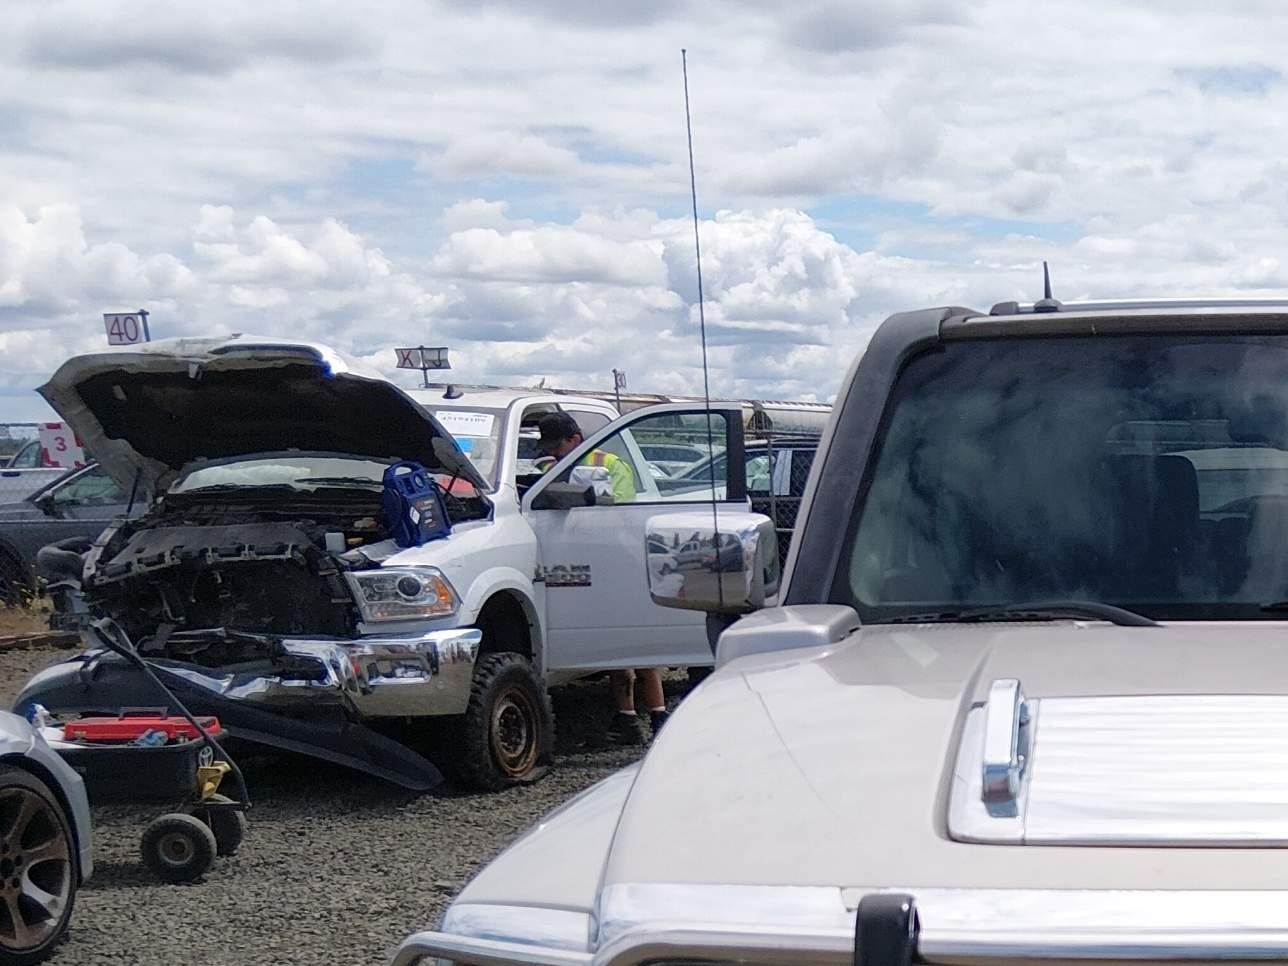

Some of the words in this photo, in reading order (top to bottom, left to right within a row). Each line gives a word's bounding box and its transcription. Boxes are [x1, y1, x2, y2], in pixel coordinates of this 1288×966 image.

[110, 316, 138, 342] 40
[401, 351, 414, 367] K
[432, 350, 442, 367] J
[54, 436, 67, 452] 3
